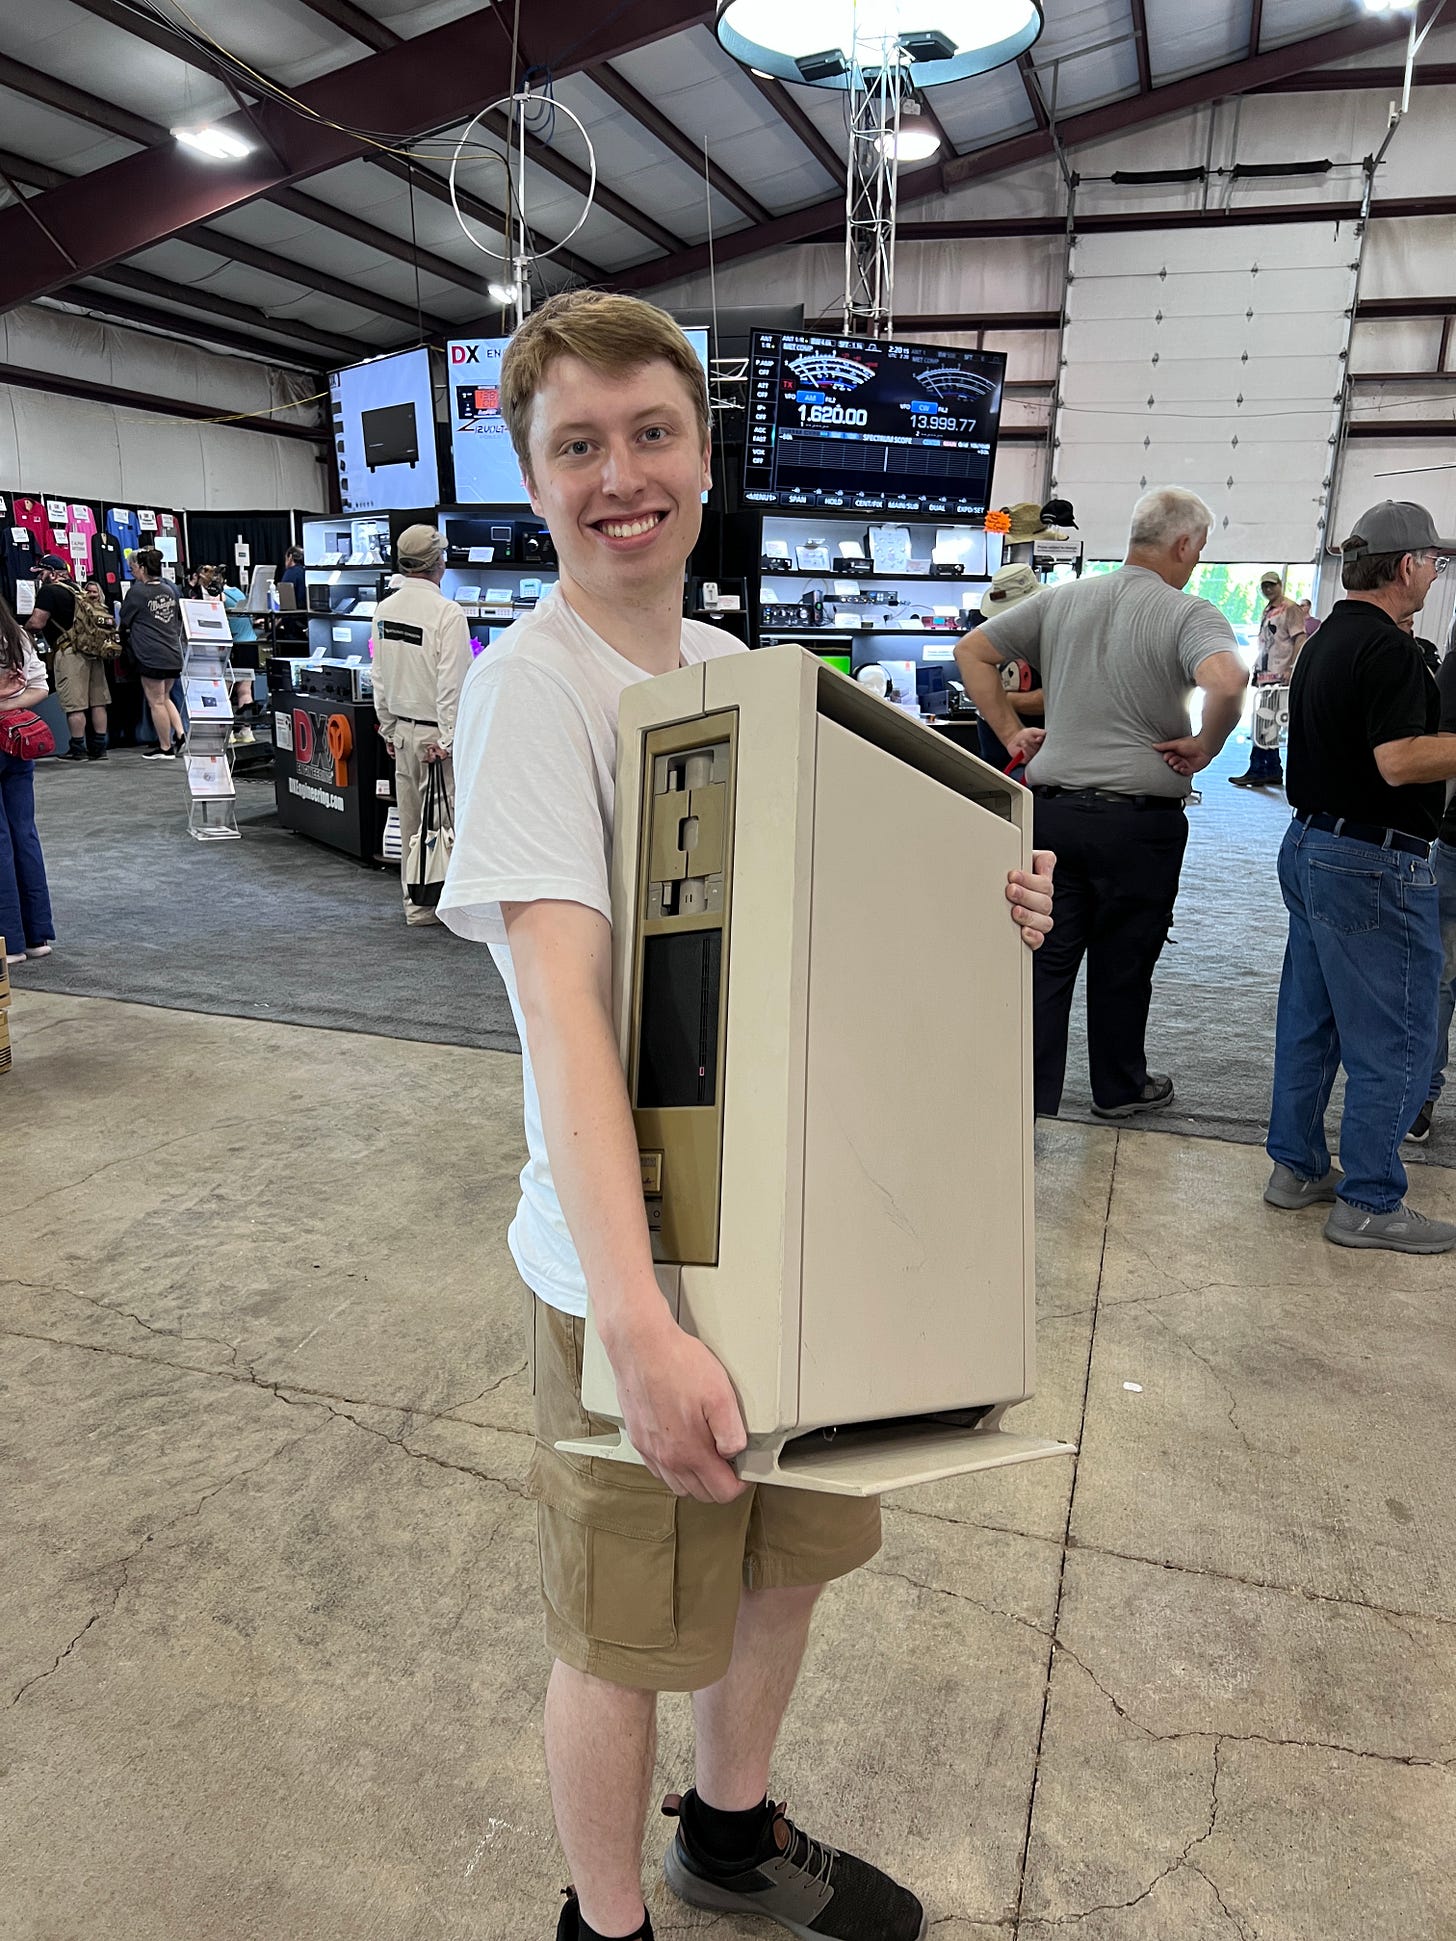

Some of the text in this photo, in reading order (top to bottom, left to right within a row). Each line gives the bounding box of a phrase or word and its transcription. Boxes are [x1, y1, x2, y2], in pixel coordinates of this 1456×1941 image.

[451, 345, 480, 364] DX
[783, 380, 793, 388] TX
[804, 394, 816, 402] AM
[798, 404, 868, 426] 1.620.00
[910, 414, 976, 432] 13.999.77
[789, 495, 806, 504] SPAN
[825, 498, 843, 506] HOLD
[929, 503, 946, 512] DUAL
[293, 708, 334, 772] DX
